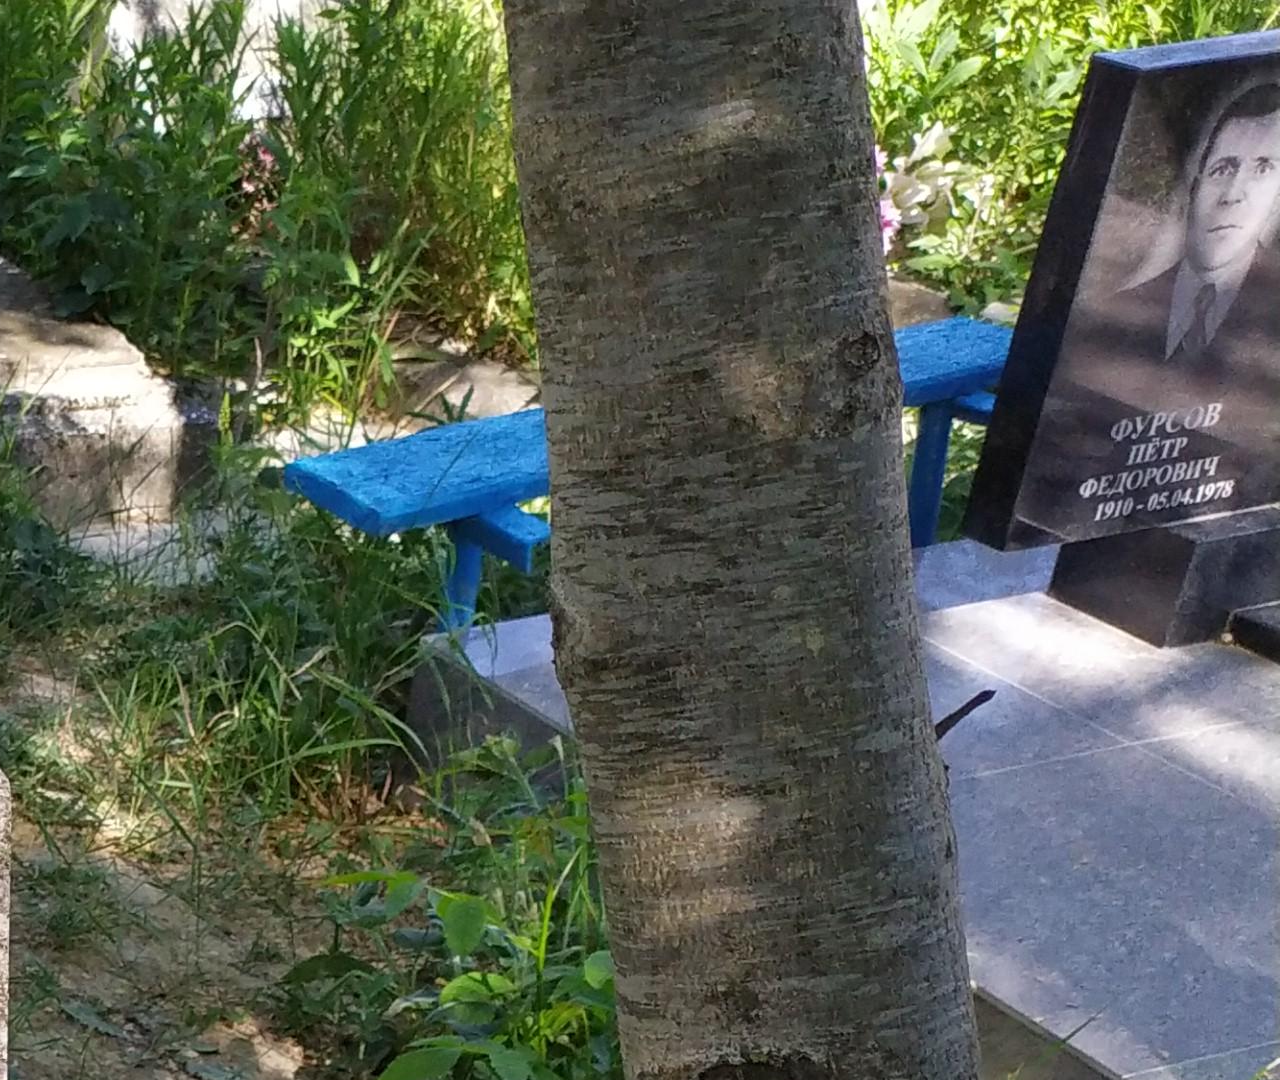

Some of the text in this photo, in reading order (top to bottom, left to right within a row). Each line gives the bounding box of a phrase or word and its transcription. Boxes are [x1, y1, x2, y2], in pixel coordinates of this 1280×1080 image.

[1110, 403, 1223, 442] ФУРСОВ
[1125, 437, 1188, 466] ПЁТР
[1078, 456, 1221, 499] ФЕДОРОВИЧ
[1093, 499, 1133, 522] 1910
[1147, 480, 1235, 511] 05.04.1978
